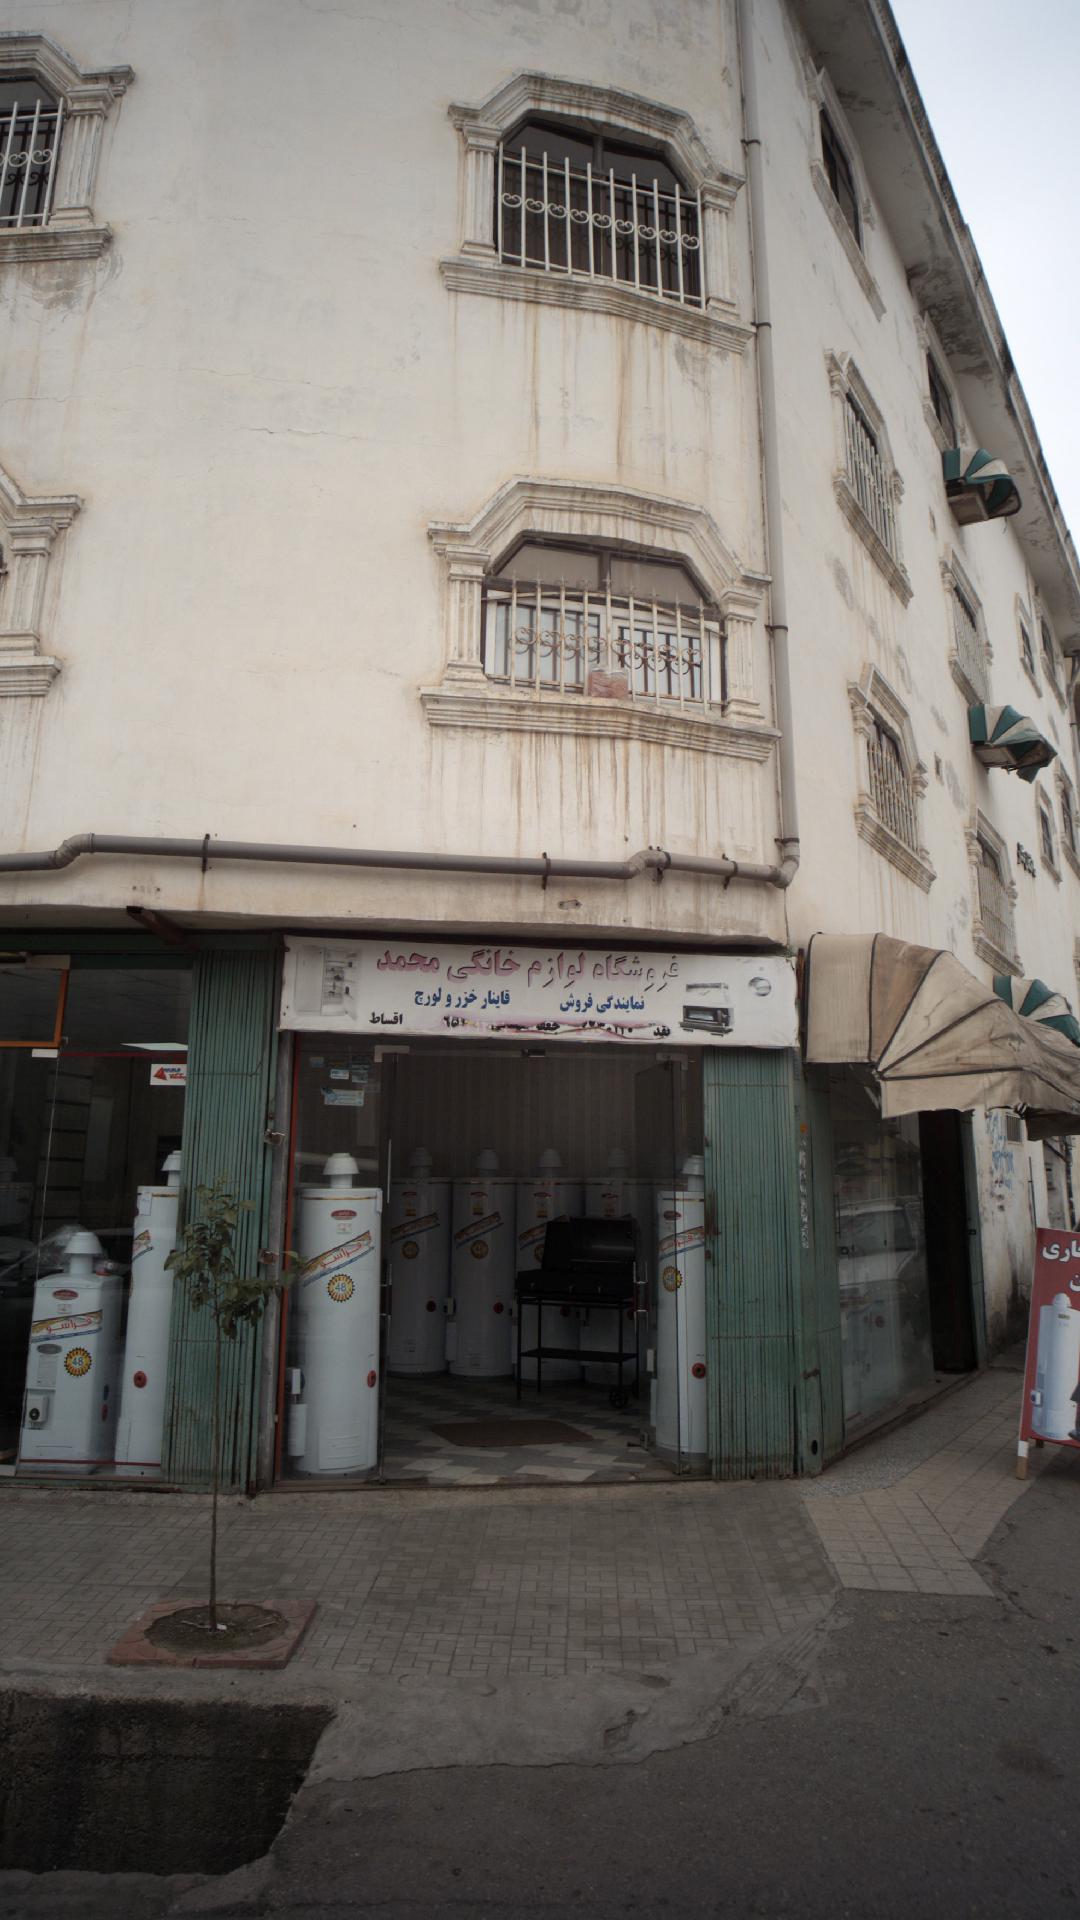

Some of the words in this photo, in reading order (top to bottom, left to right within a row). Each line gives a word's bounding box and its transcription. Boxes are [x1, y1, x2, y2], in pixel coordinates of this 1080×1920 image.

[376, 949, 440, 974] محمد
[446, 948, 521, 983] خانگی
[527, 951, 586, 988] لوازم
[593, 954, 679, 992] فروشگاه
[445, 993, 452, 1008] و
[454, 987, 478, 1008] خزر
[559, 992, 593, 1013] فروش
[595, 994, 645, 1013] نمایندگی
[368, 1010, 404, 1025] اقساط
